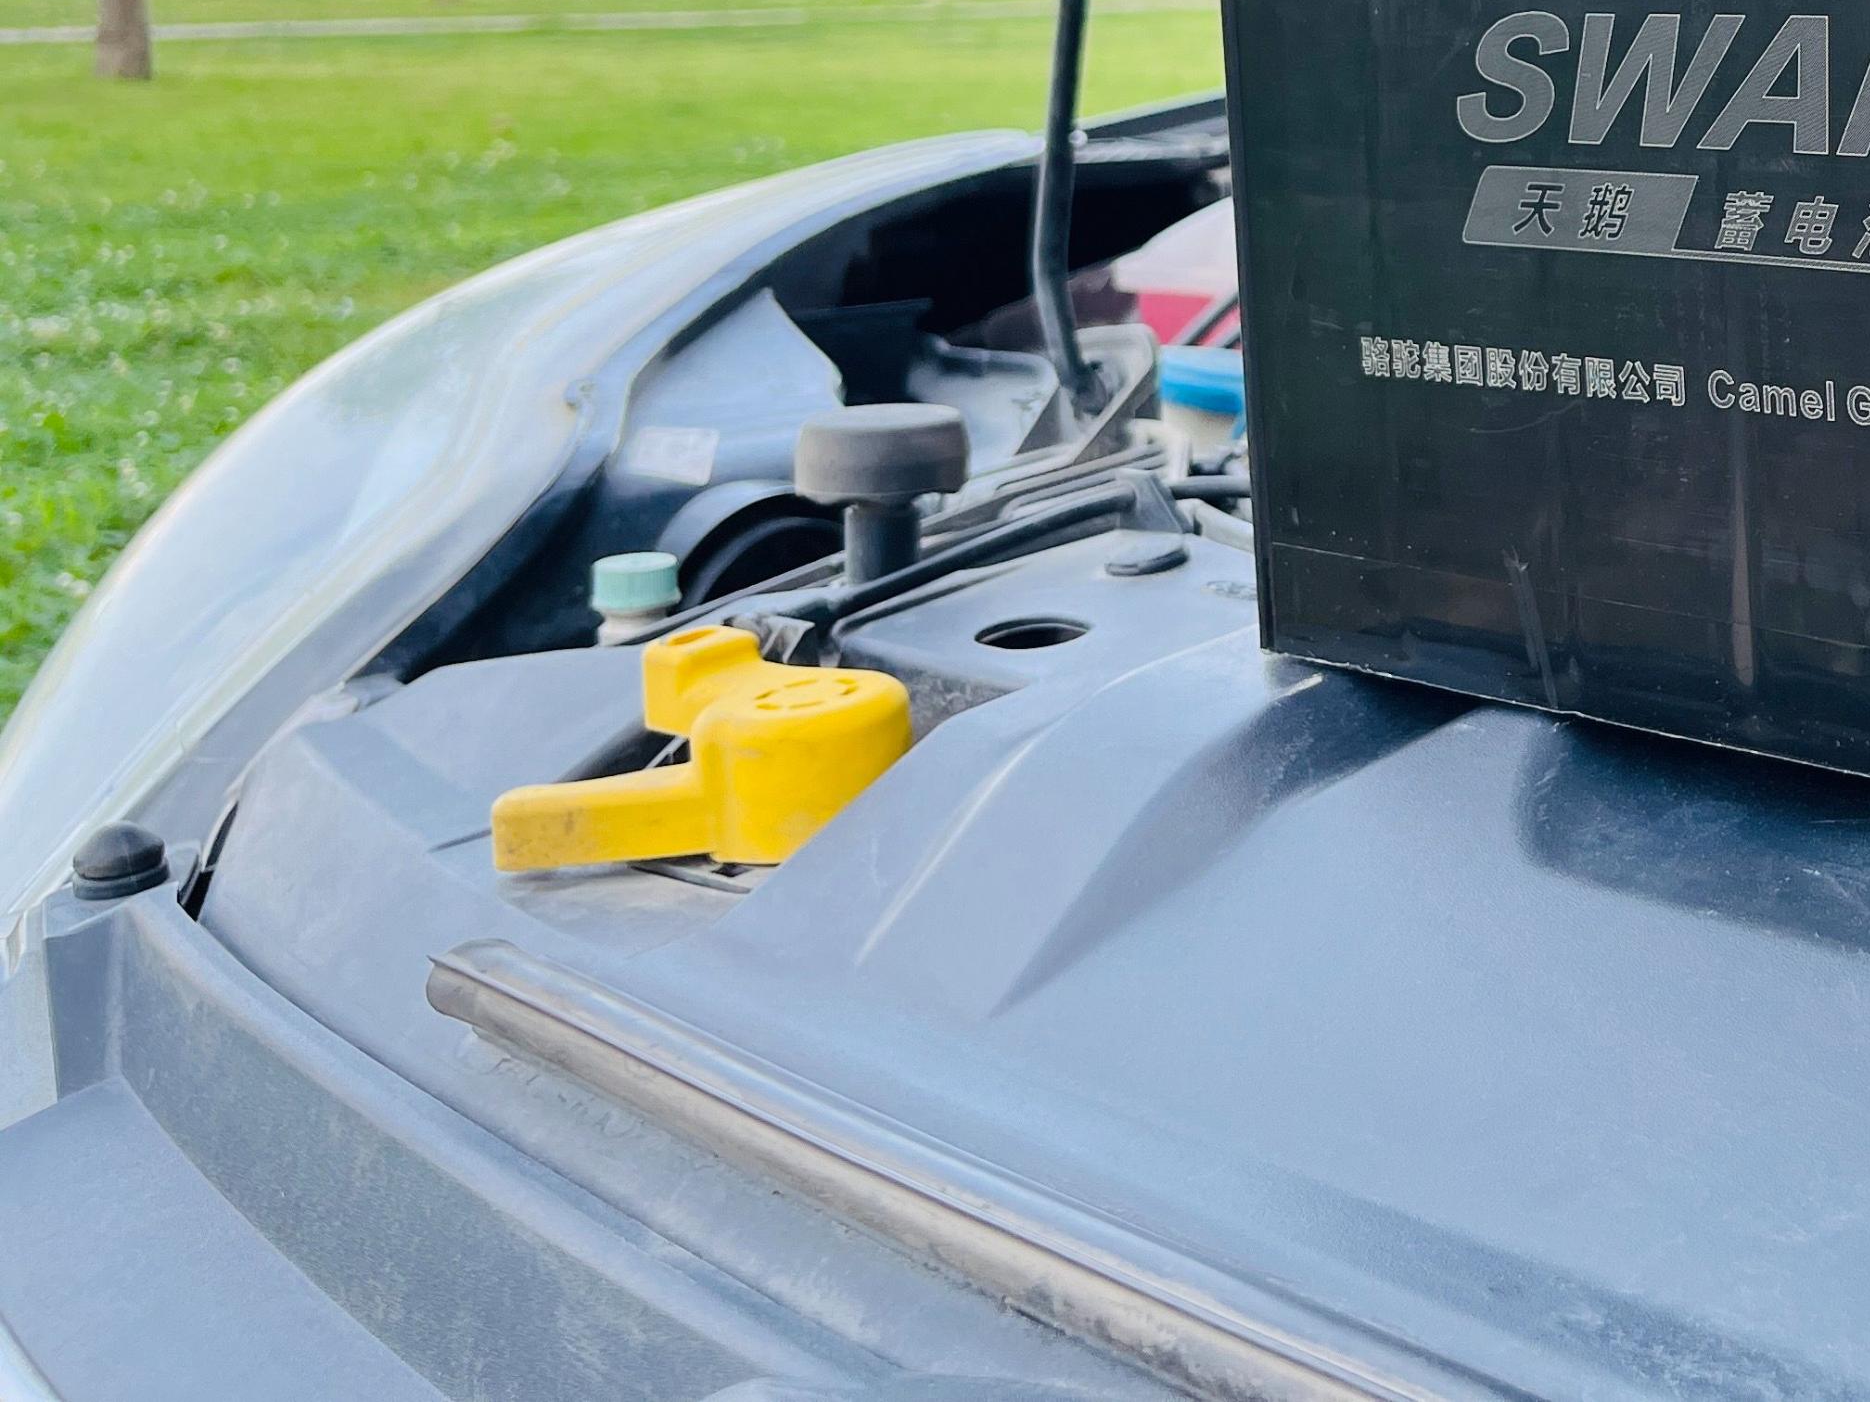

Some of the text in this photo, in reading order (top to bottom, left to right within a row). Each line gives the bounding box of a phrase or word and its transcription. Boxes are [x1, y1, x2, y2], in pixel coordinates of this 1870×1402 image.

[1513, 182, 1635, 241] 天鹅
[1360, 336, 1687, 407] 骆驼集团股份有限公司
[1707, 369, 1836, 422] Camel
